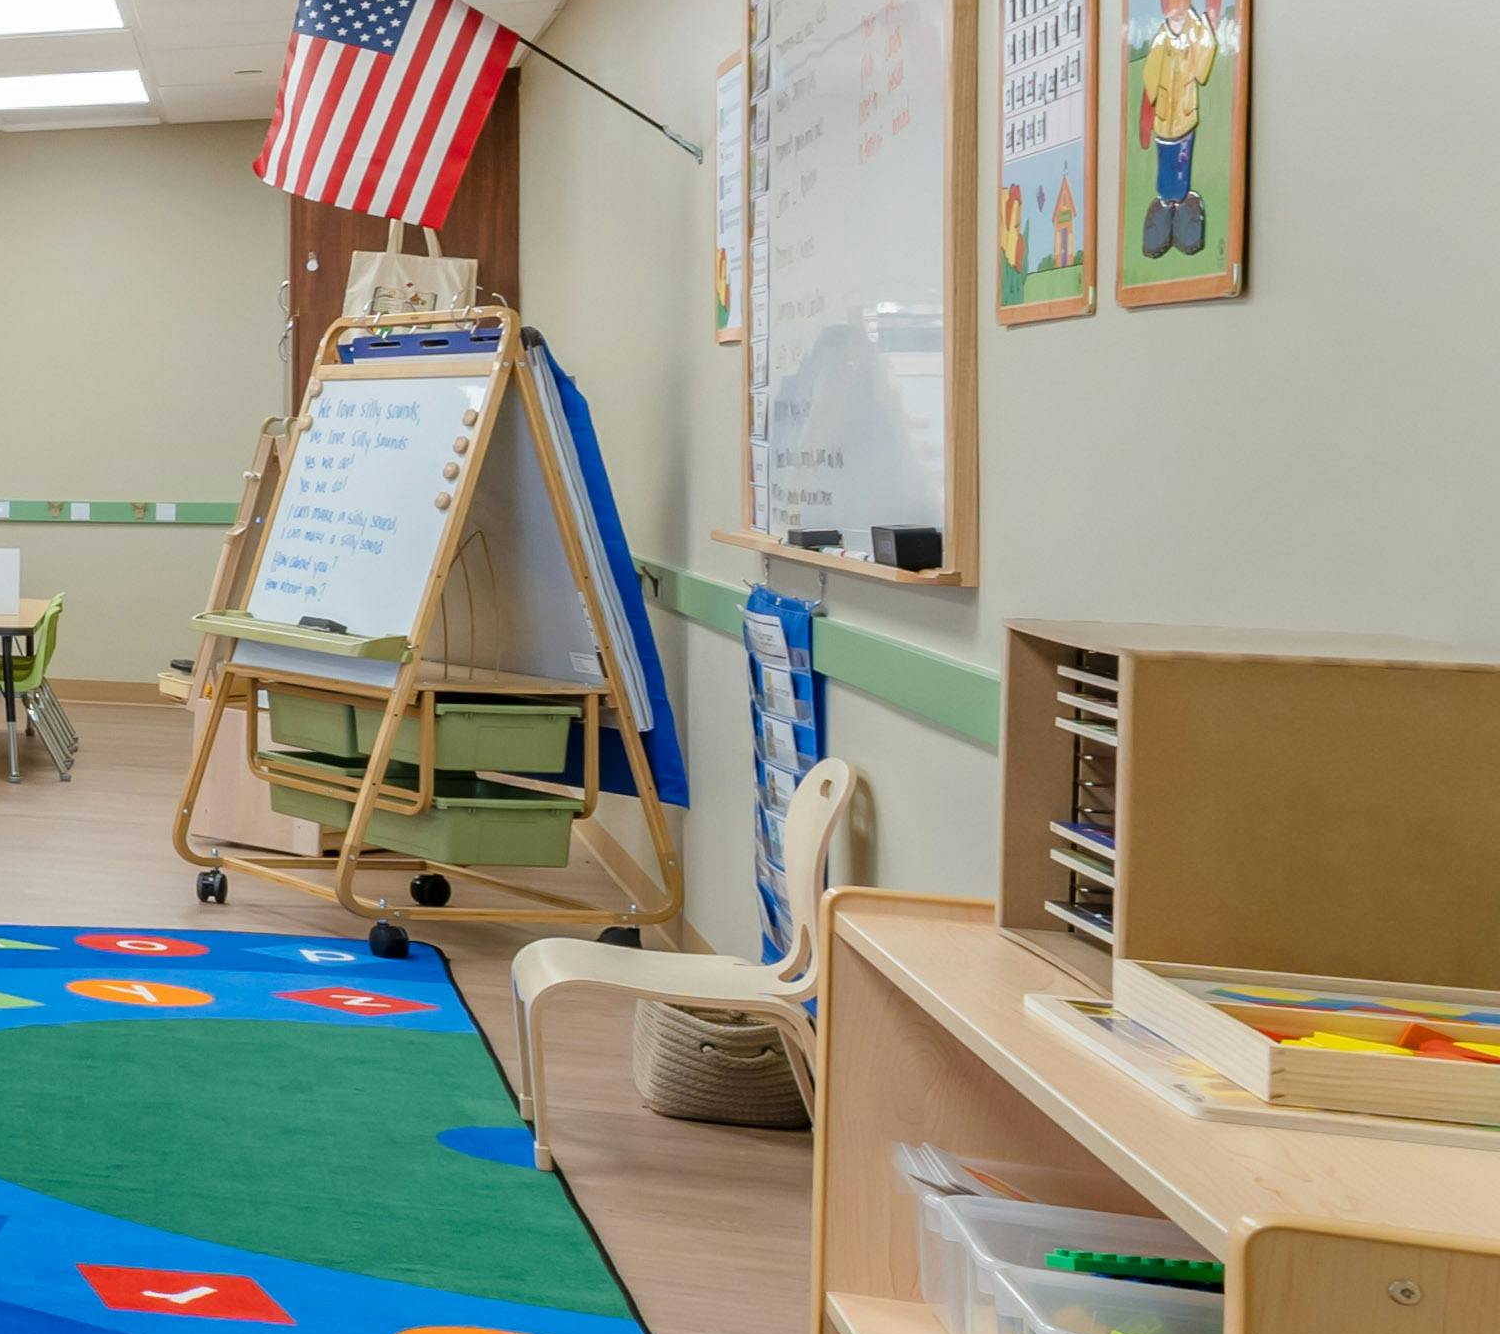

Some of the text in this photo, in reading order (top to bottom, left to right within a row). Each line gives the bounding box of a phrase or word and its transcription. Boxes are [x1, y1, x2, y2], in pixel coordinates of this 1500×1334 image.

[336, 400, 356, 418] love
[328, 429, 345, 445] love
[115, 939, 167, 952] o
[299, 948, 357, 964] p
[101, 983, 160, 1003] y
[330, 994, 391, 1008] z
[141, 1284, 217, 1304] r
